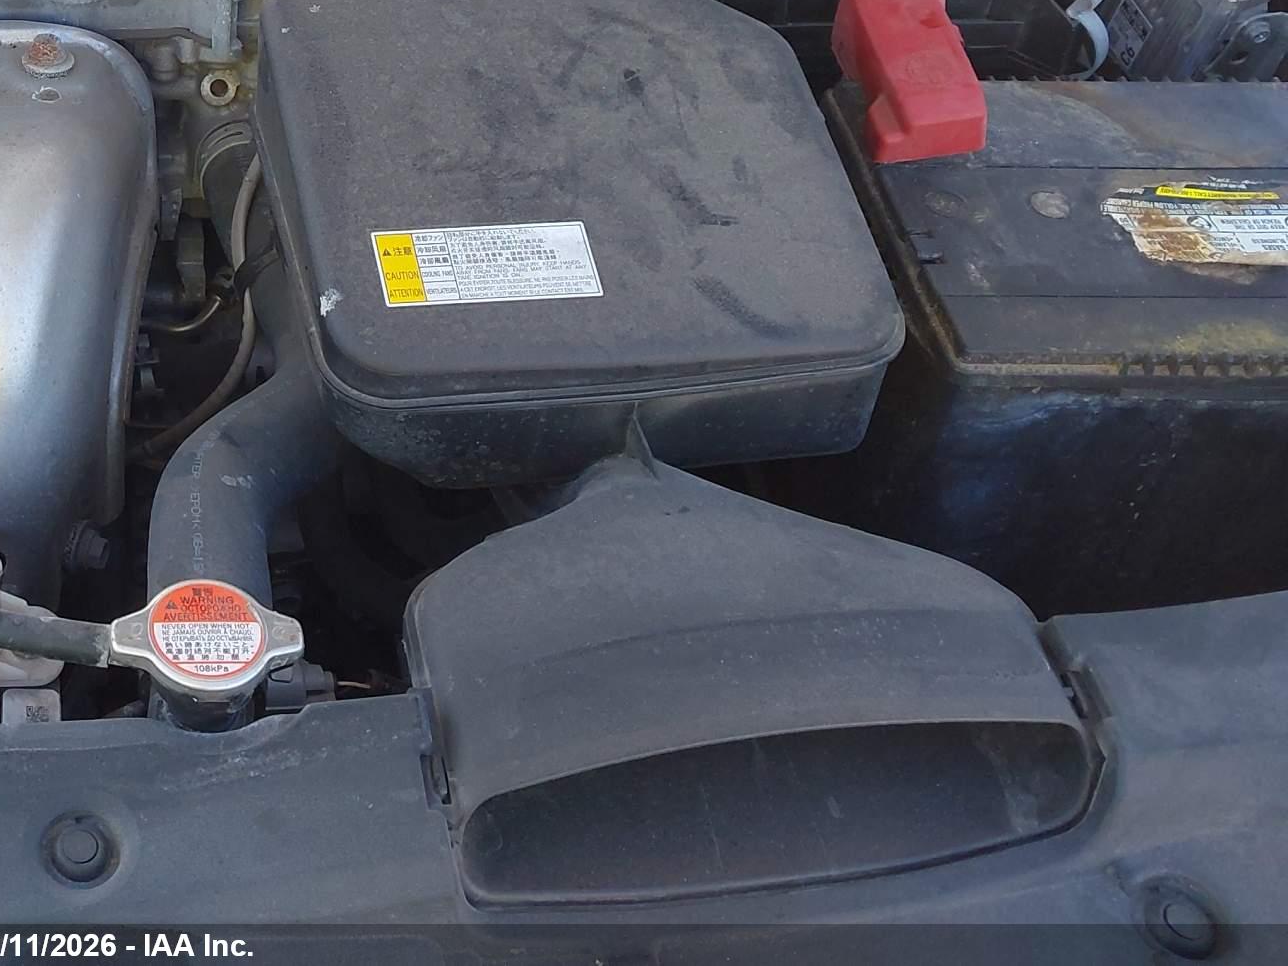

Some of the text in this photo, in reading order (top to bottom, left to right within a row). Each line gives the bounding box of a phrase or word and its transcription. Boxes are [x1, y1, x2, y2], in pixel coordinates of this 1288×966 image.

[385, 271, 420, 281] CAUTION
[389, 288, 424, 298] ATTENTION
[180, 596, 234, 604] WARNING
[163, 612, 249, 622] AVERTISSEMENT
